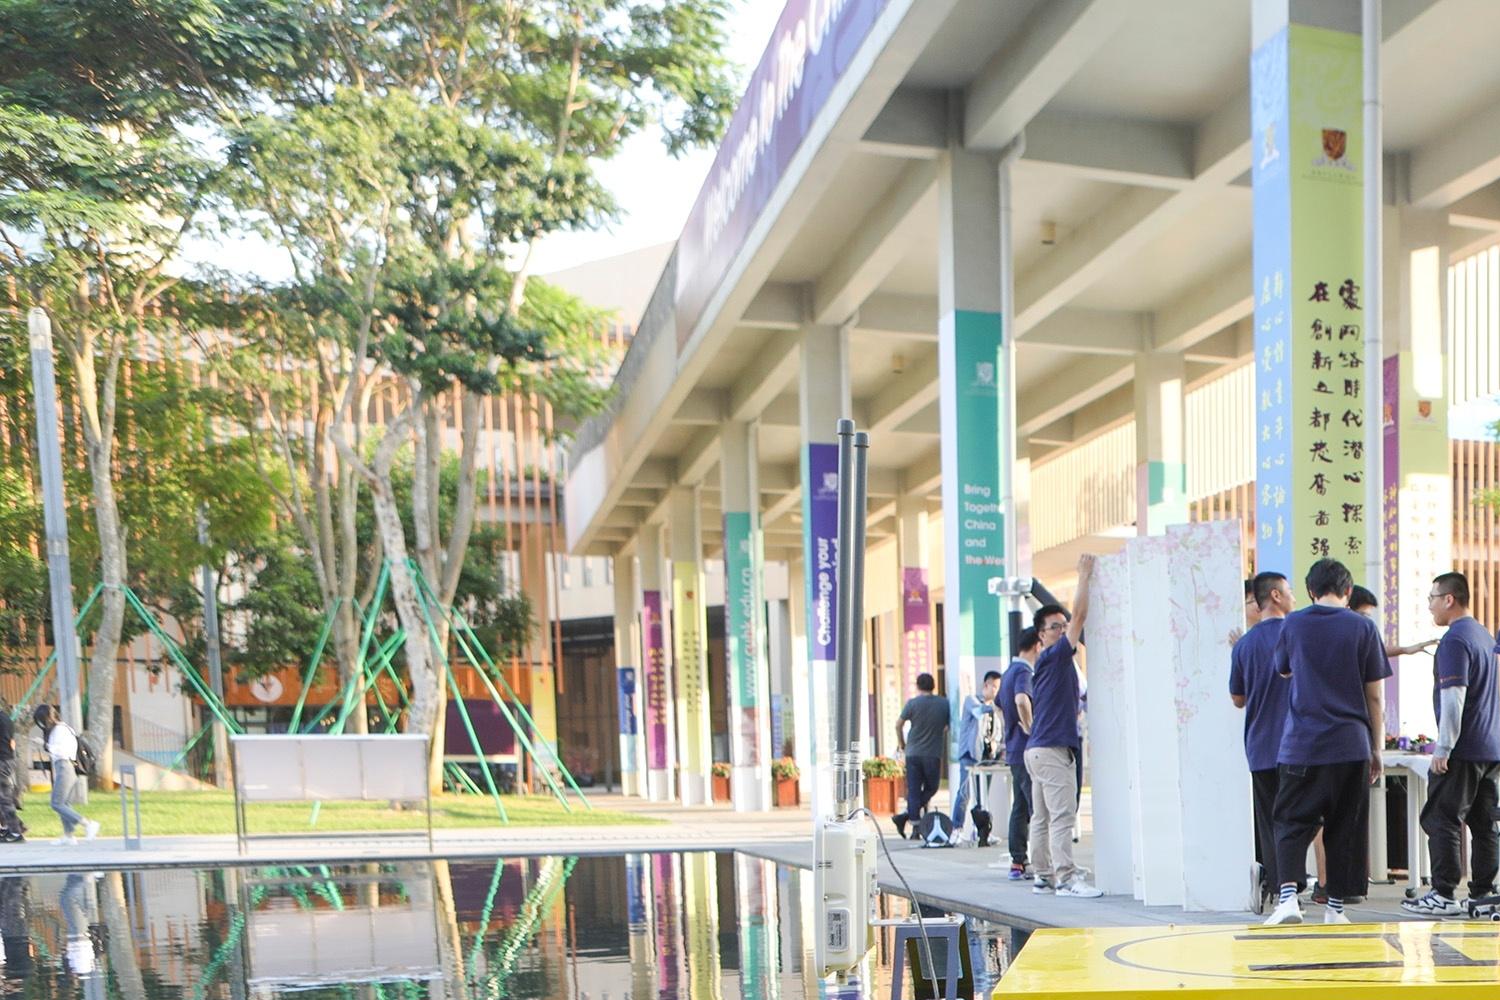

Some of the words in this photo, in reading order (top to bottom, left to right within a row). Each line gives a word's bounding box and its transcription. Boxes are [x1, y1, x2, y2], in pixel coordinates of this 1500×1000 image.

[964, 483, 991, 498] Bring
[964, 519, 997, 531] China
[964, 536, 987, 548] and
[817, 537, 832, 570] your
[965, 555, 983, 565] the
[817, 571, 833, 646] Challenge
